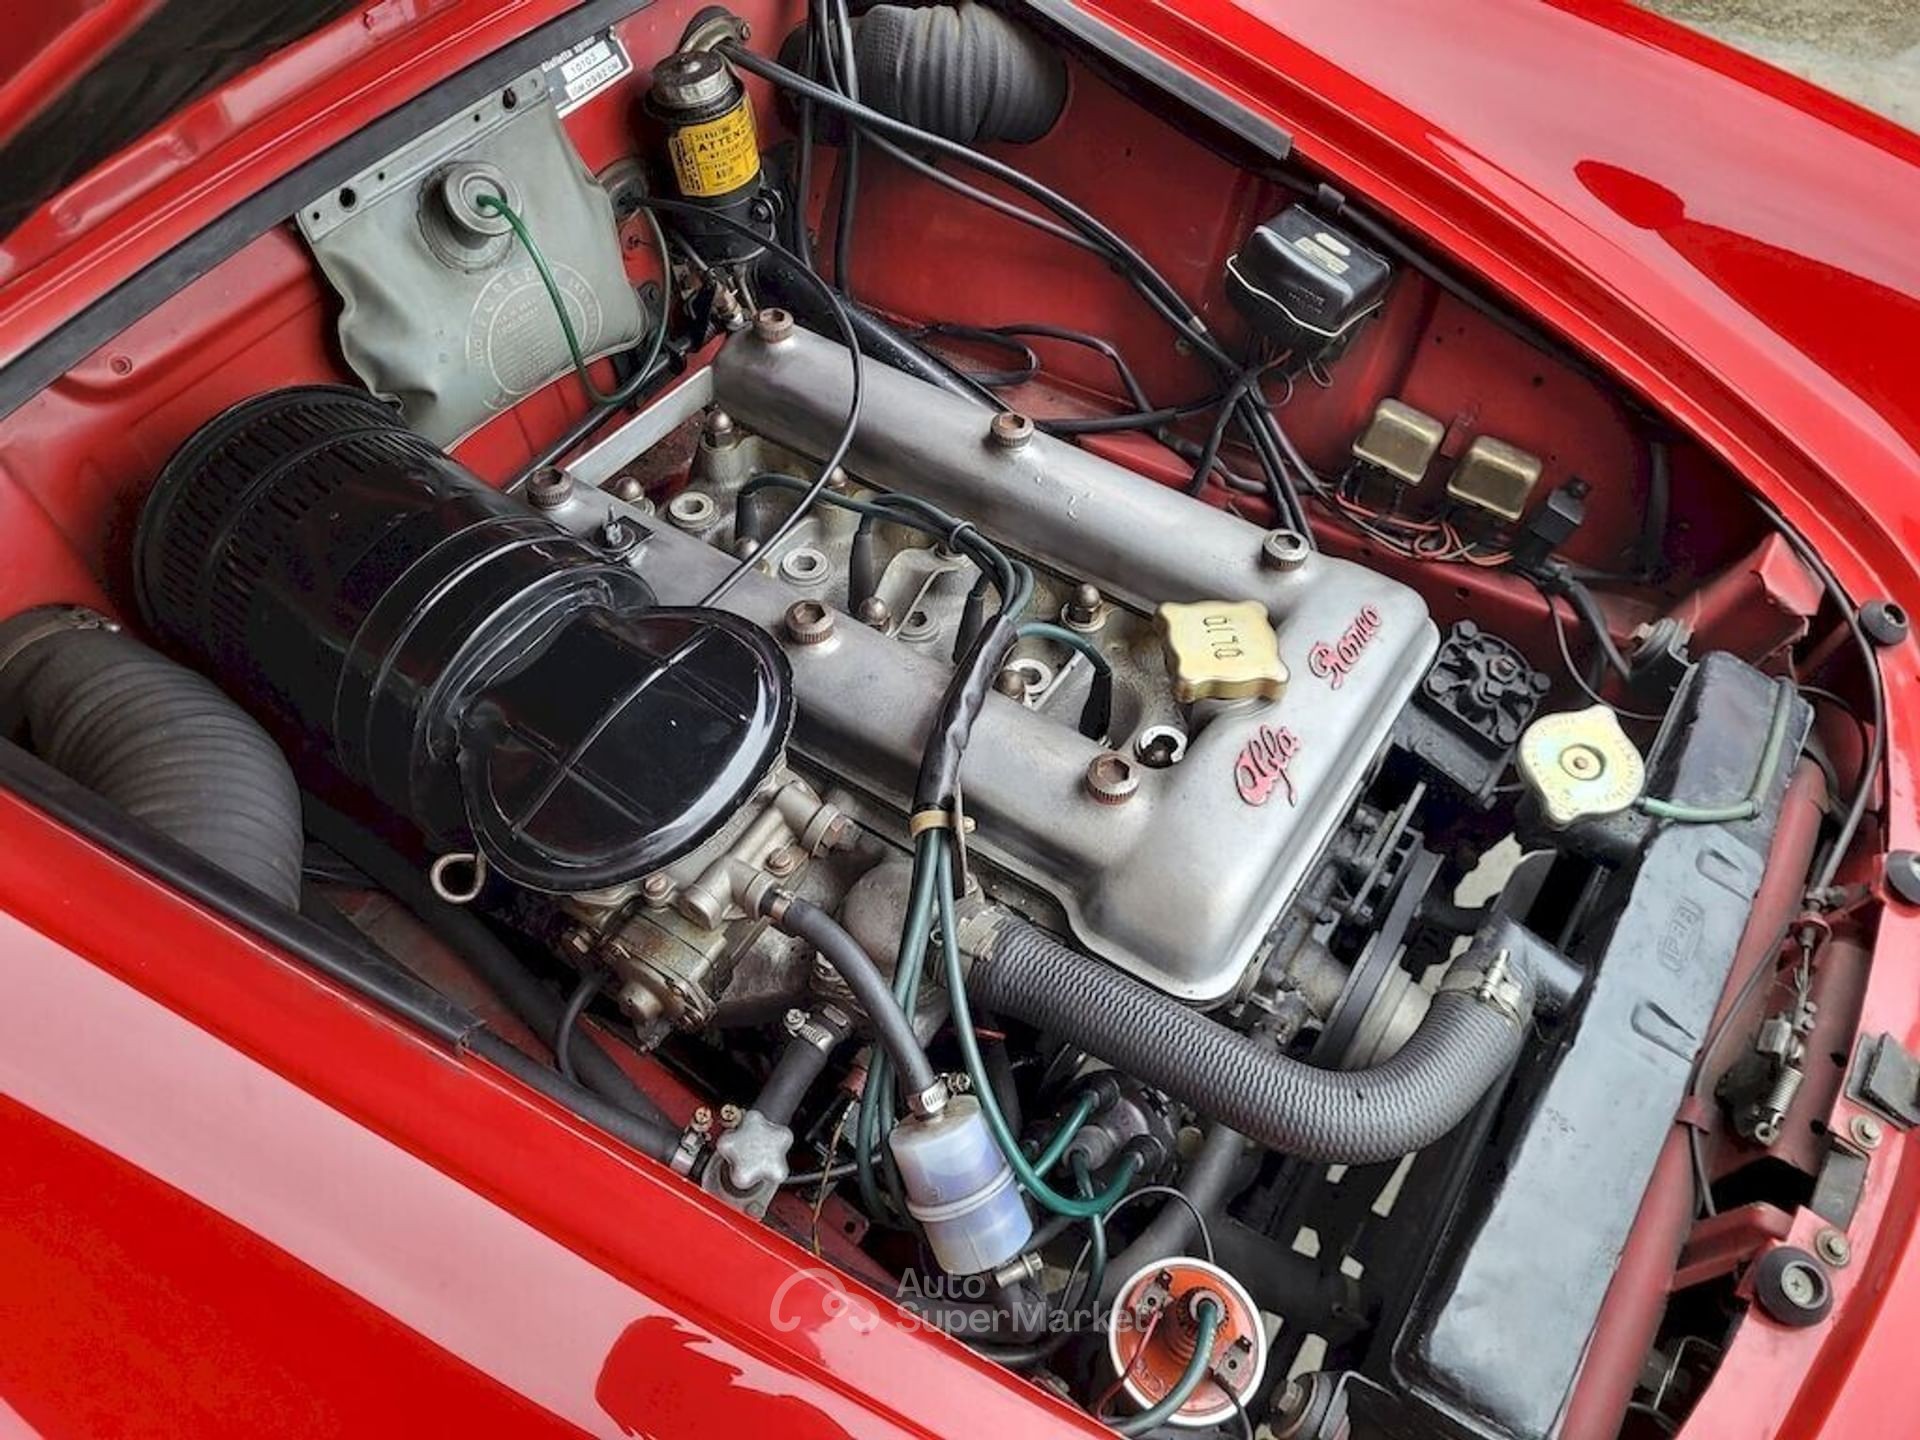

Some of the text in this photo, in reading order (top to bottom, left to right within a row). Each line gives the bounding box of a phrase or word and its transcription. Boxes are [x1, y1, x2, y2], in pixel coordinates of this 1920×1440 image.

[1202, 613, 1245, 662] OLIO
[1307, 603, 1383, 691] Romeo
[1234, 722, 1303, 808] Alfa
